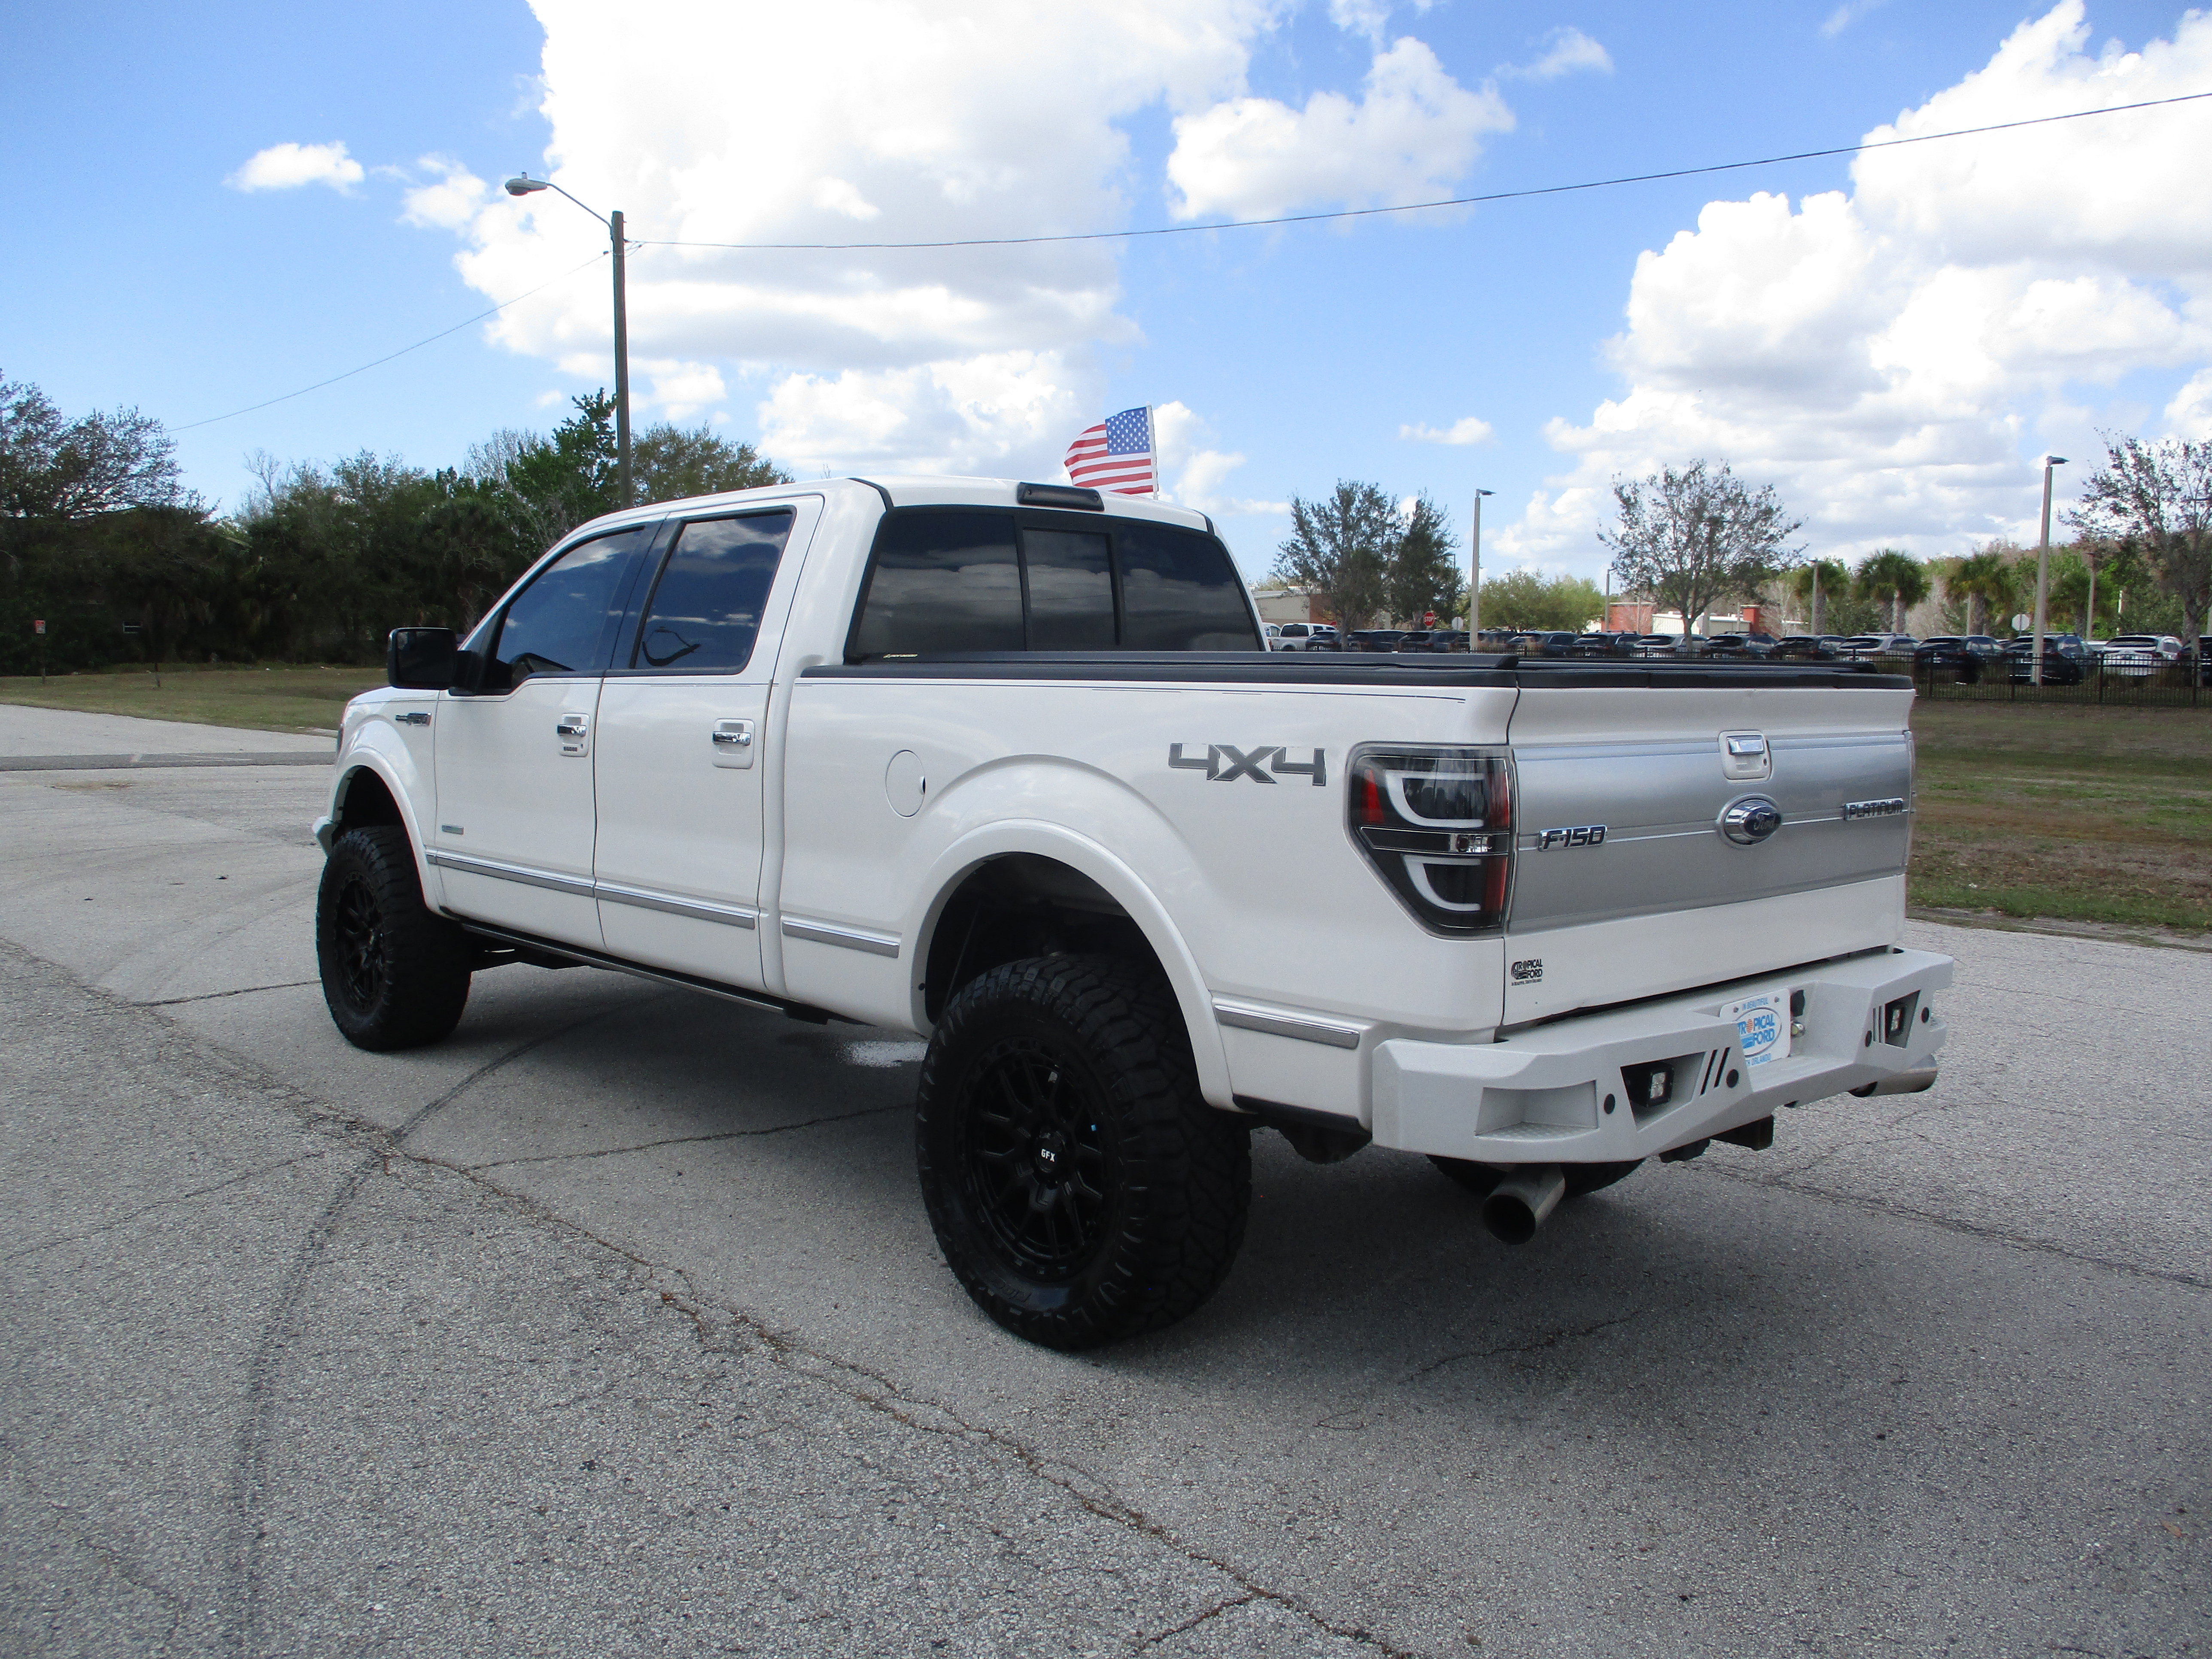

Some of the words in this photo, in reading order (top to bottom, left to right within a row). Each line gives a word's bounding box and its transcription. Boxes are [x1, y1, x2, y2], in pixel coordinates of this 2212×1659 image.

[1168, 743, 1326, 786] 4X4
[1527, 968, 1543, 978] FORD
[1737, 1014, 1775, 1035] TROPICAL
[1753, 1028, 1775, 1045] FORD
[1041, 1149, 1055, 1162] GFX
